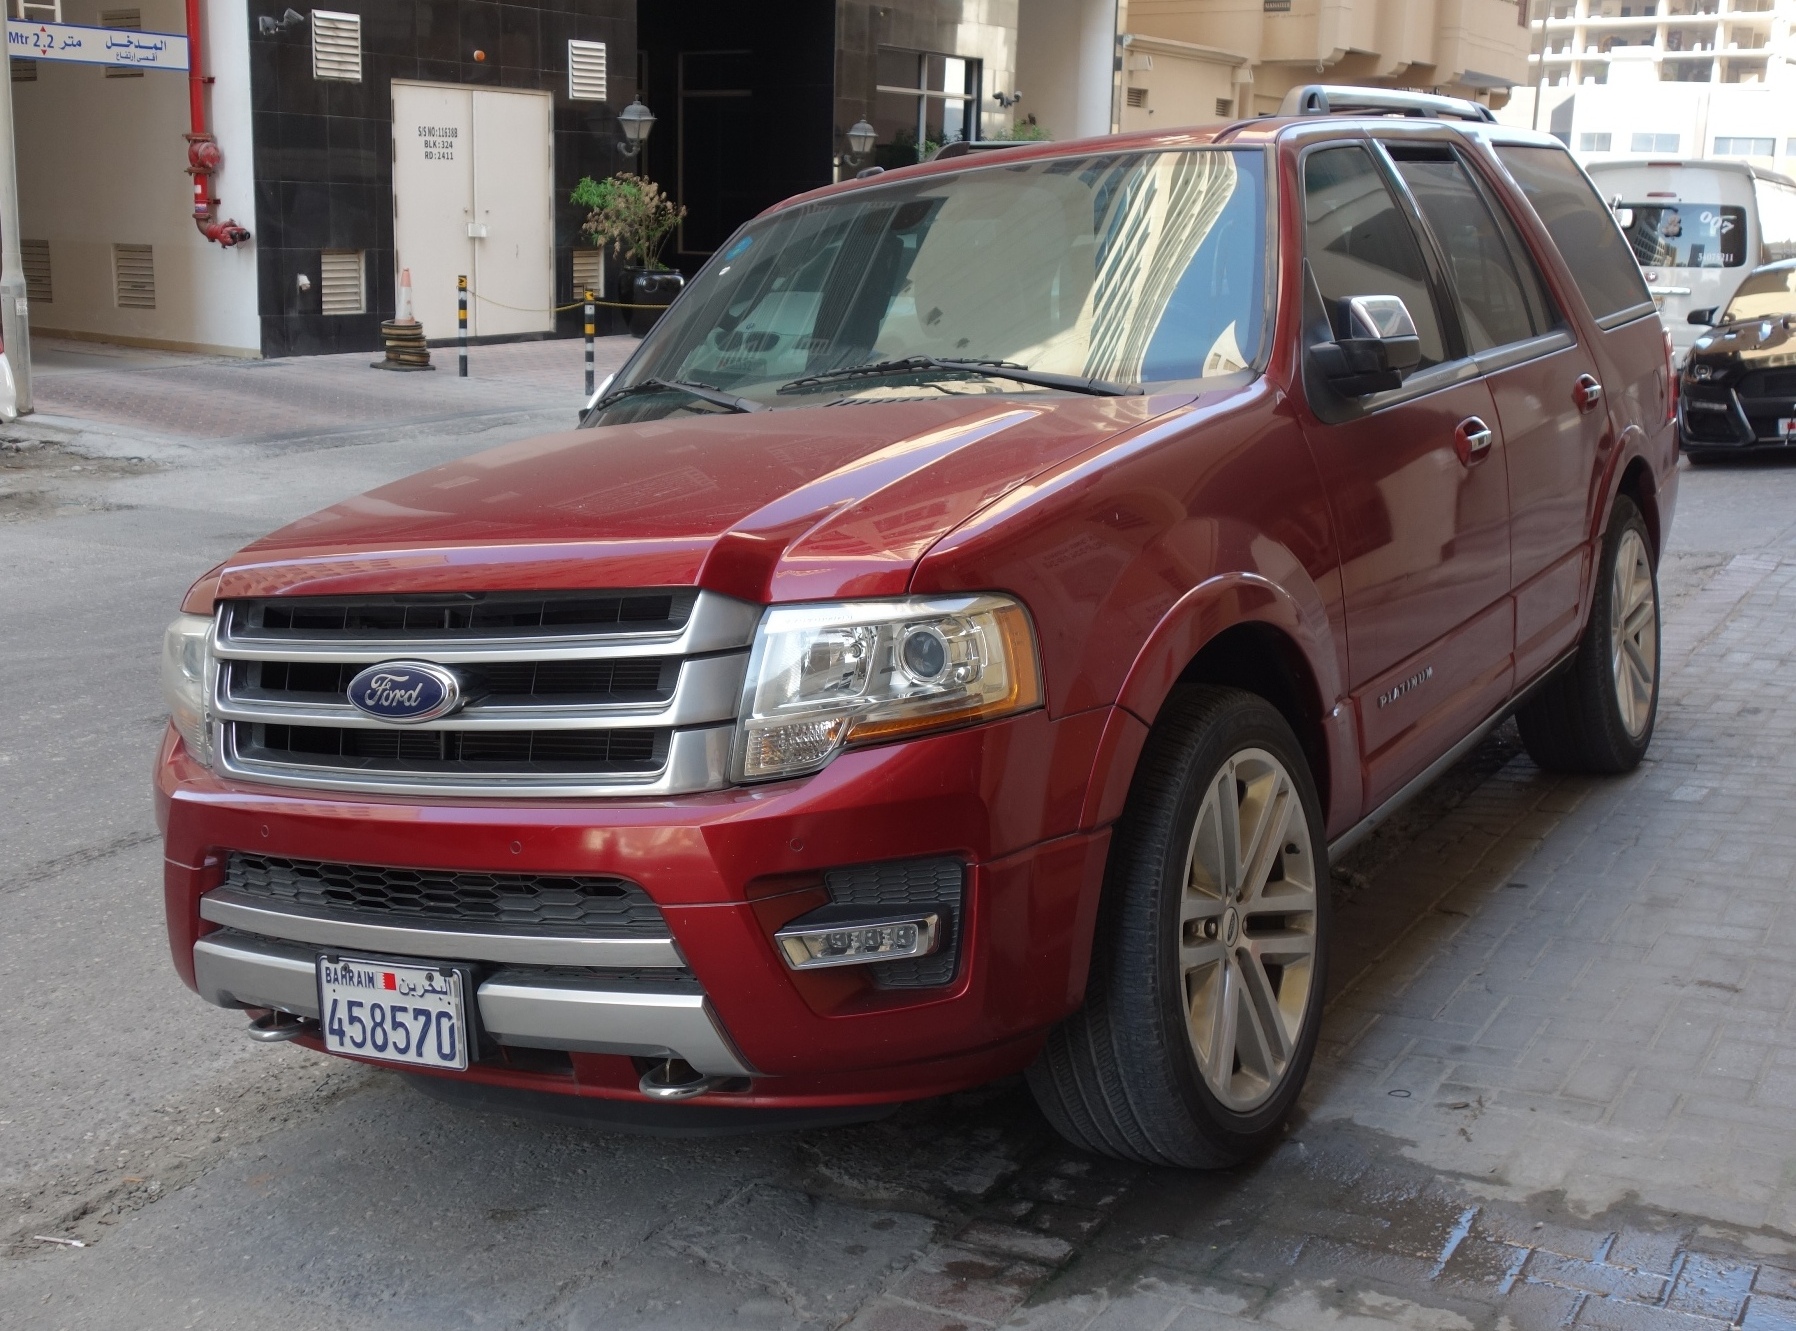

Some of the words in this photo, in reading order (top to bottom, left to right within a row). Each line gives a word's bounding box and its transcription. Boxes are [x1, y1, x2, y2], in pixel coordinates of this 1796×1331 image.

[8, 31, 29, 45] Mtr
[33, 33, 54, 48] 2.2
[59, 35, 82, 50] متر
[106, 35, 167, 51] المدخل
[364, 673, 423, 707] Ford
[1378, 666, 1434, 708] PLATINUM
[324, 966, 375, 989] BAHRAIN
[399, 975, 451, 1001] البحرين
[328, 998, 457, 1061] 458570
